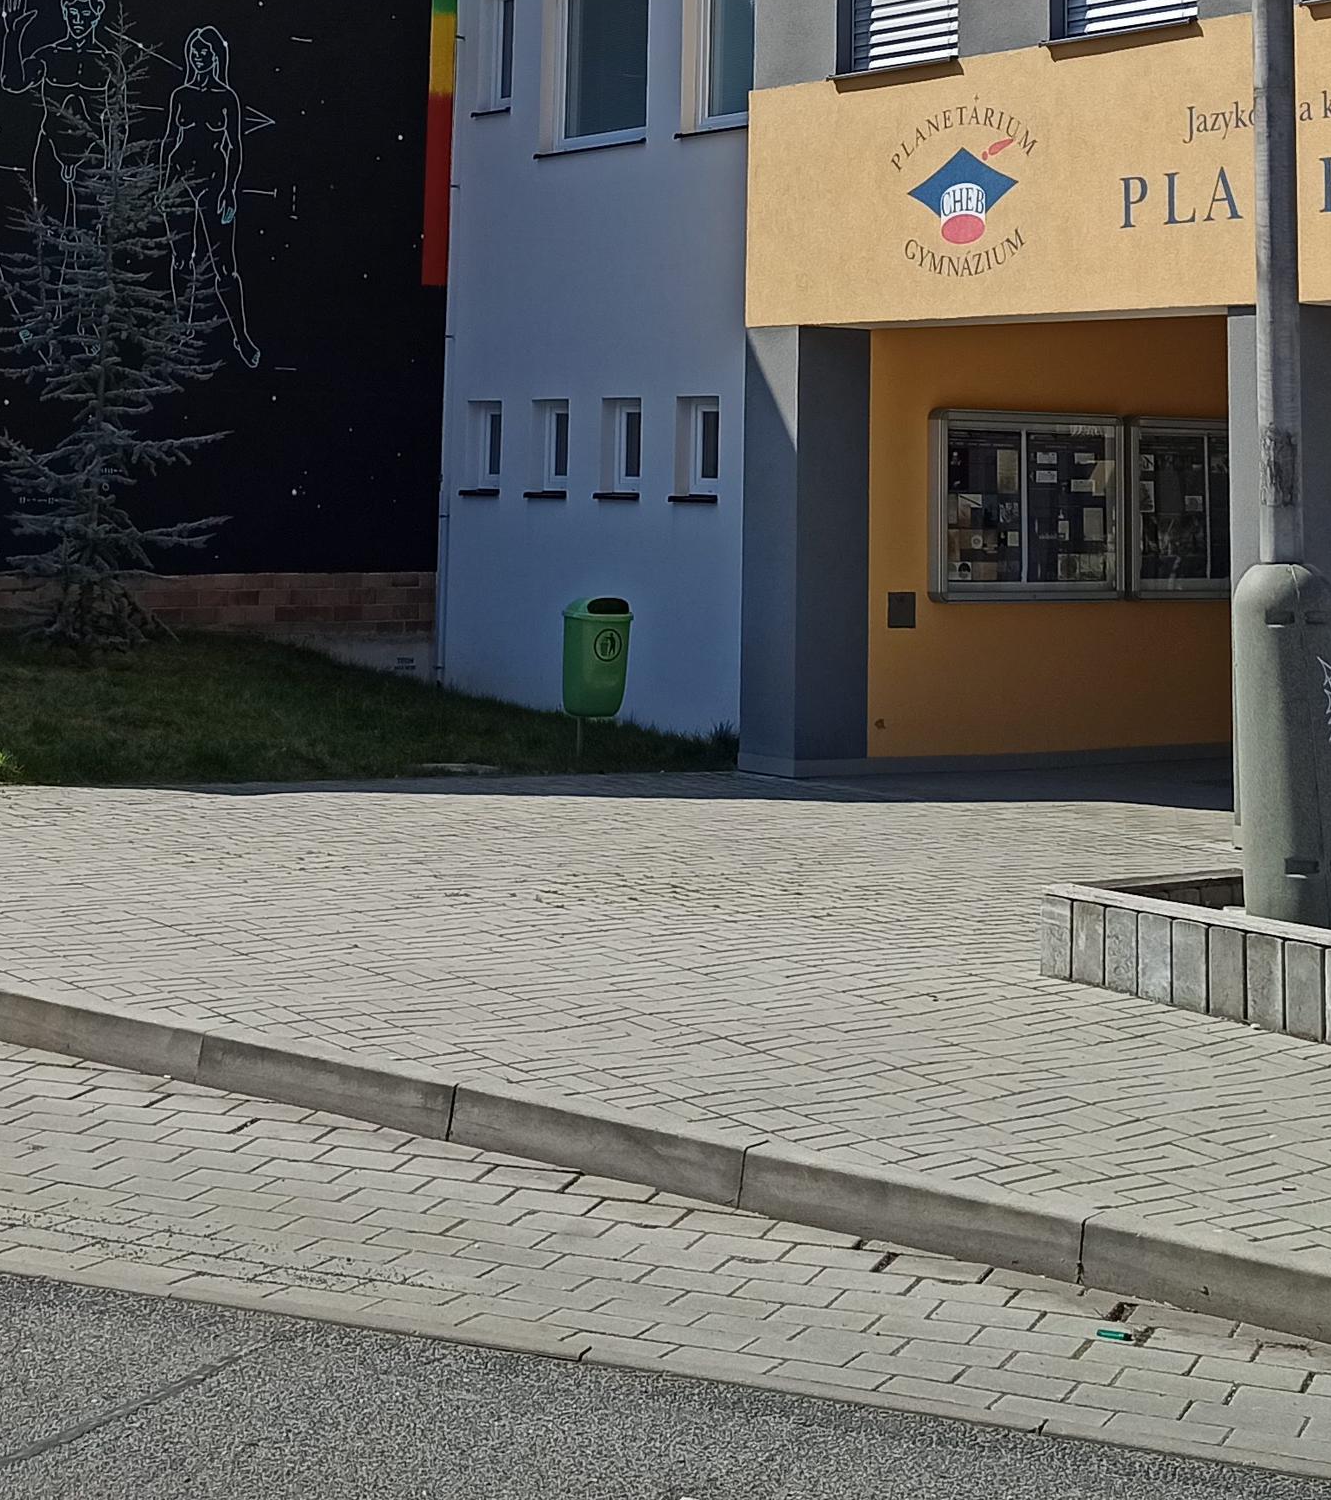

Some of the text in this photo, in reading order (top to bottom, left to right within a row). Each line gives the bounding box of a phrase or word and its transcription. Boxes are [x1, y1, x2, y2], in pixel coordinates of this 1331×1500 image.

[1182, 100, 1256, 144] Jazyk
[1298, 101, 1314, 122] a
[941, 187, 986, 217] CHEB
[904, 227, 1027, 278] GYMNÁZIUM
